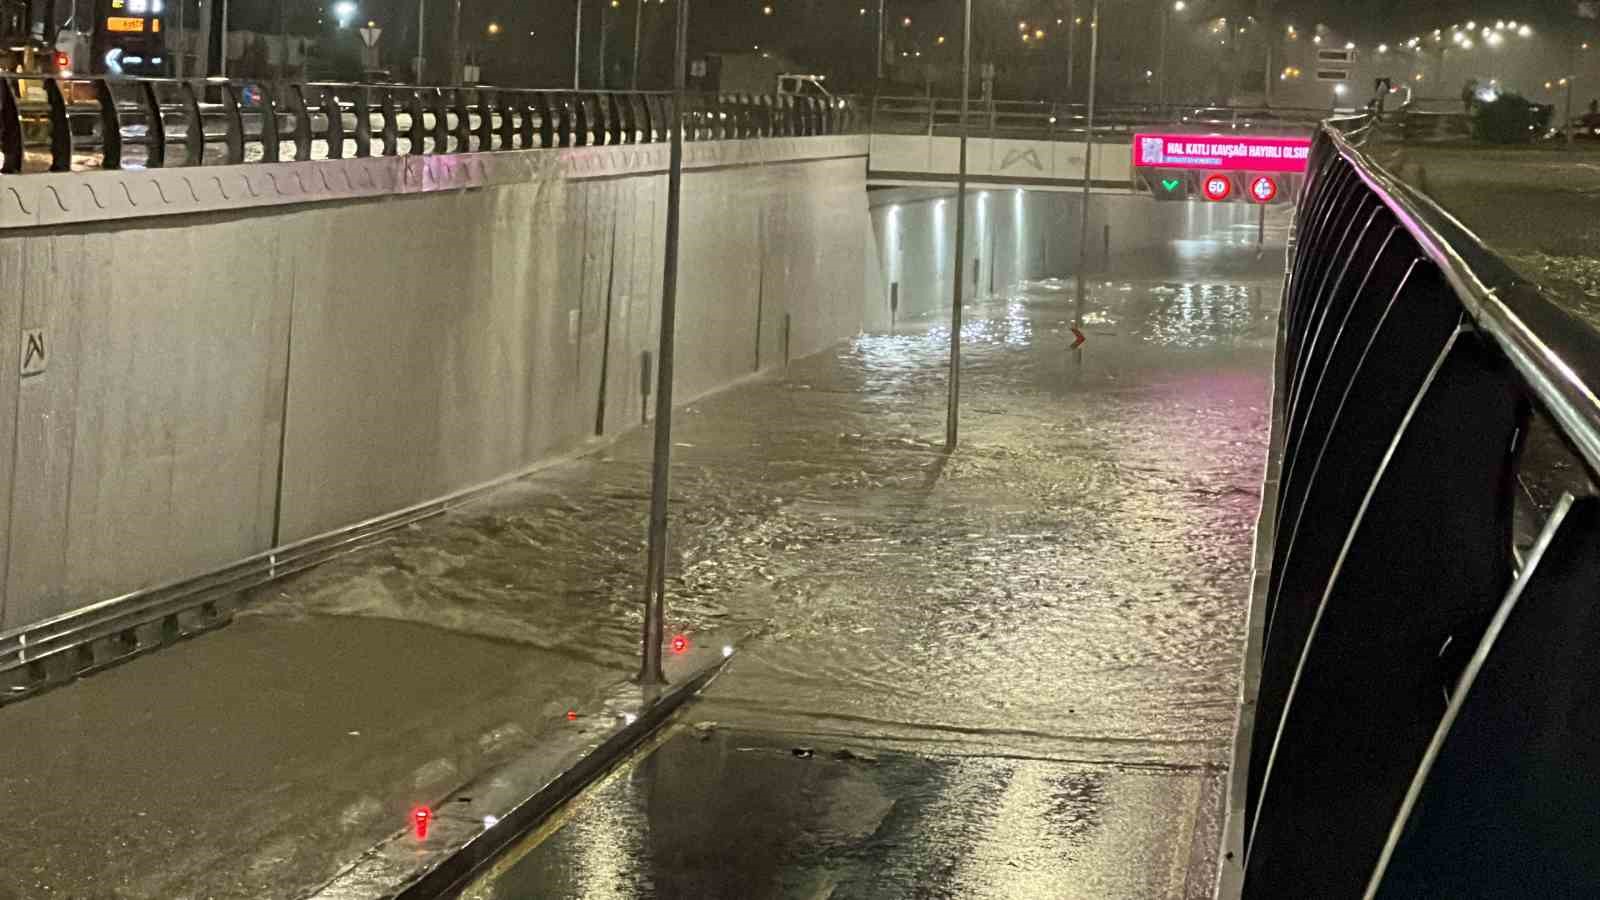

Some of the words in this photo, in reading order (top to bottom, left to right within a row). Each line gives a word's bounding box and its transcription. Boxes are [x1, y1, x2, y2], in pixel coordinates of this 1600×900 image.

[1167, 142, 1185, 155] HAL
[1186, 143, 1210, 156] KATLI
[1211, 142, 1247, 158] KAVŞAĞI
[1249, 145, 1282, 158] HAYIRLI
